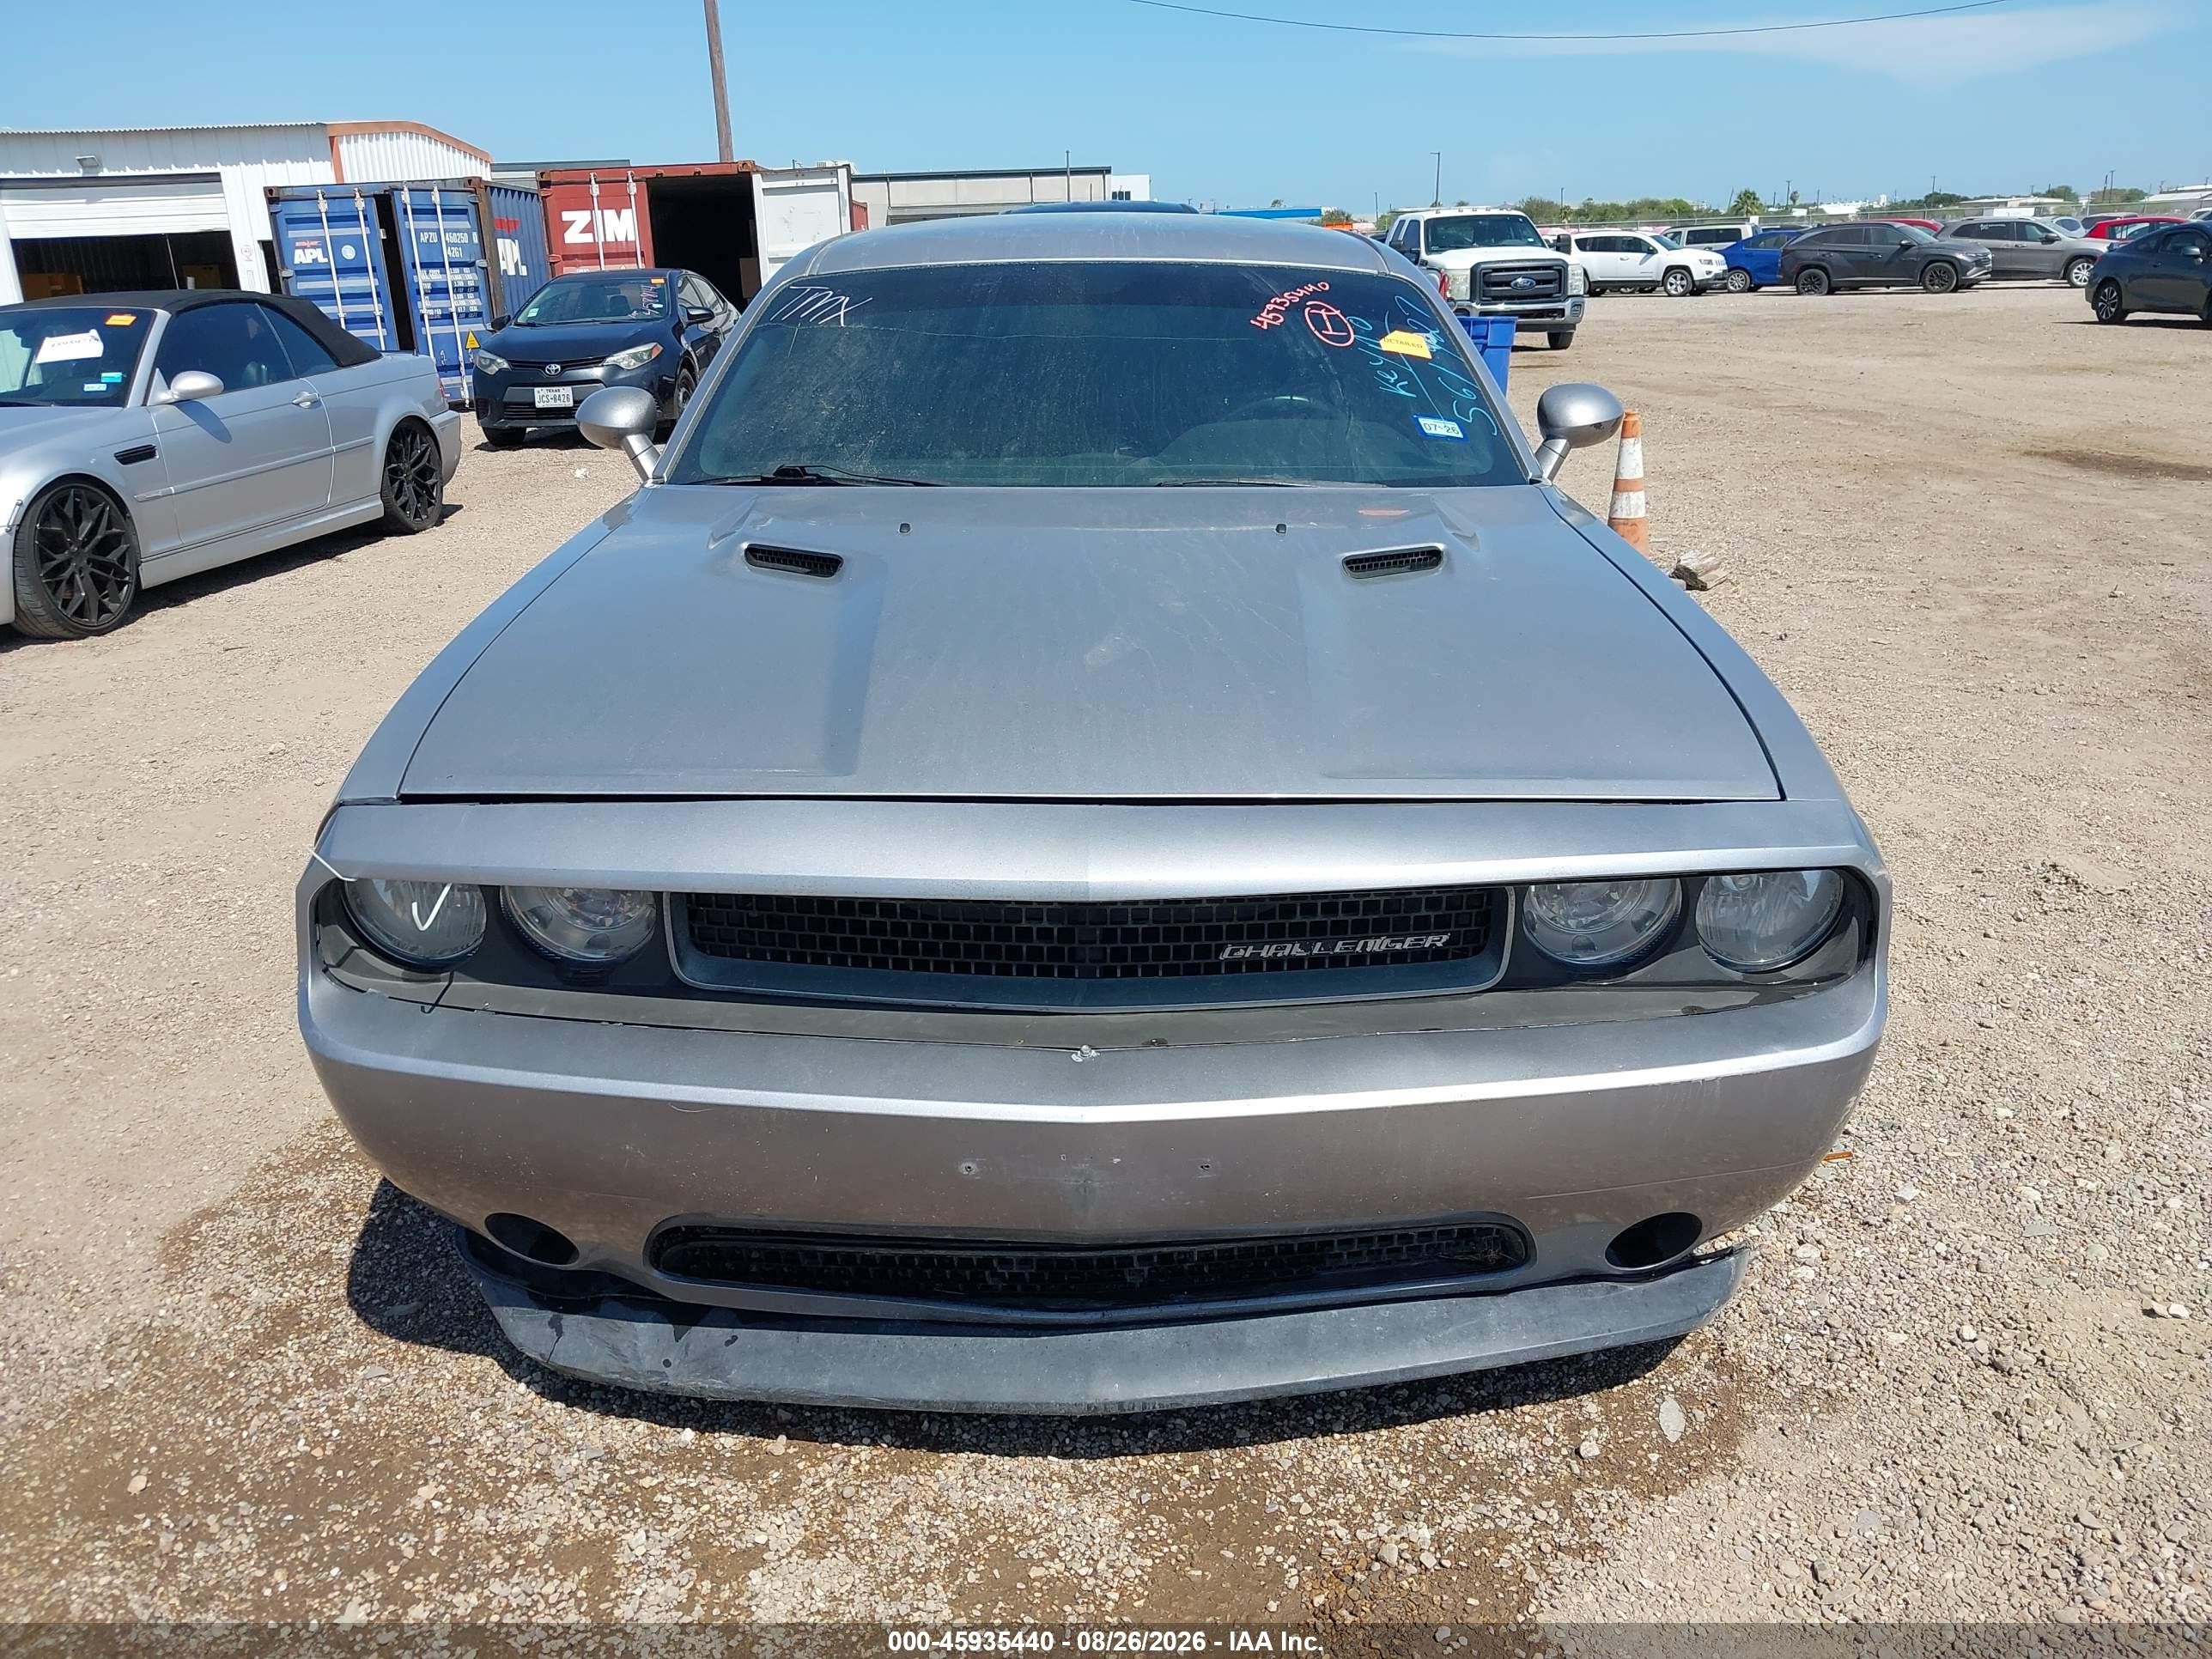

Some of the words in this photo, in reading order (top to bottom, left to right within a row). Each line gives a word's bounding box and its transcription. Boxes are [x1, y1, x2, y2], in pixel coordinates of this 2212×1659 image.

[420, 232, 438, 243] APZU
[561, 209, 635, 244] ZIM
[294, 247, 329, 264] APL
[447, 246, 462, 258] 42G1
[496, 238, 527, 276] APL
[1250, 281, 1330, 330] 45935440
[1219, 933, 1451, 960] CHALLENGER
